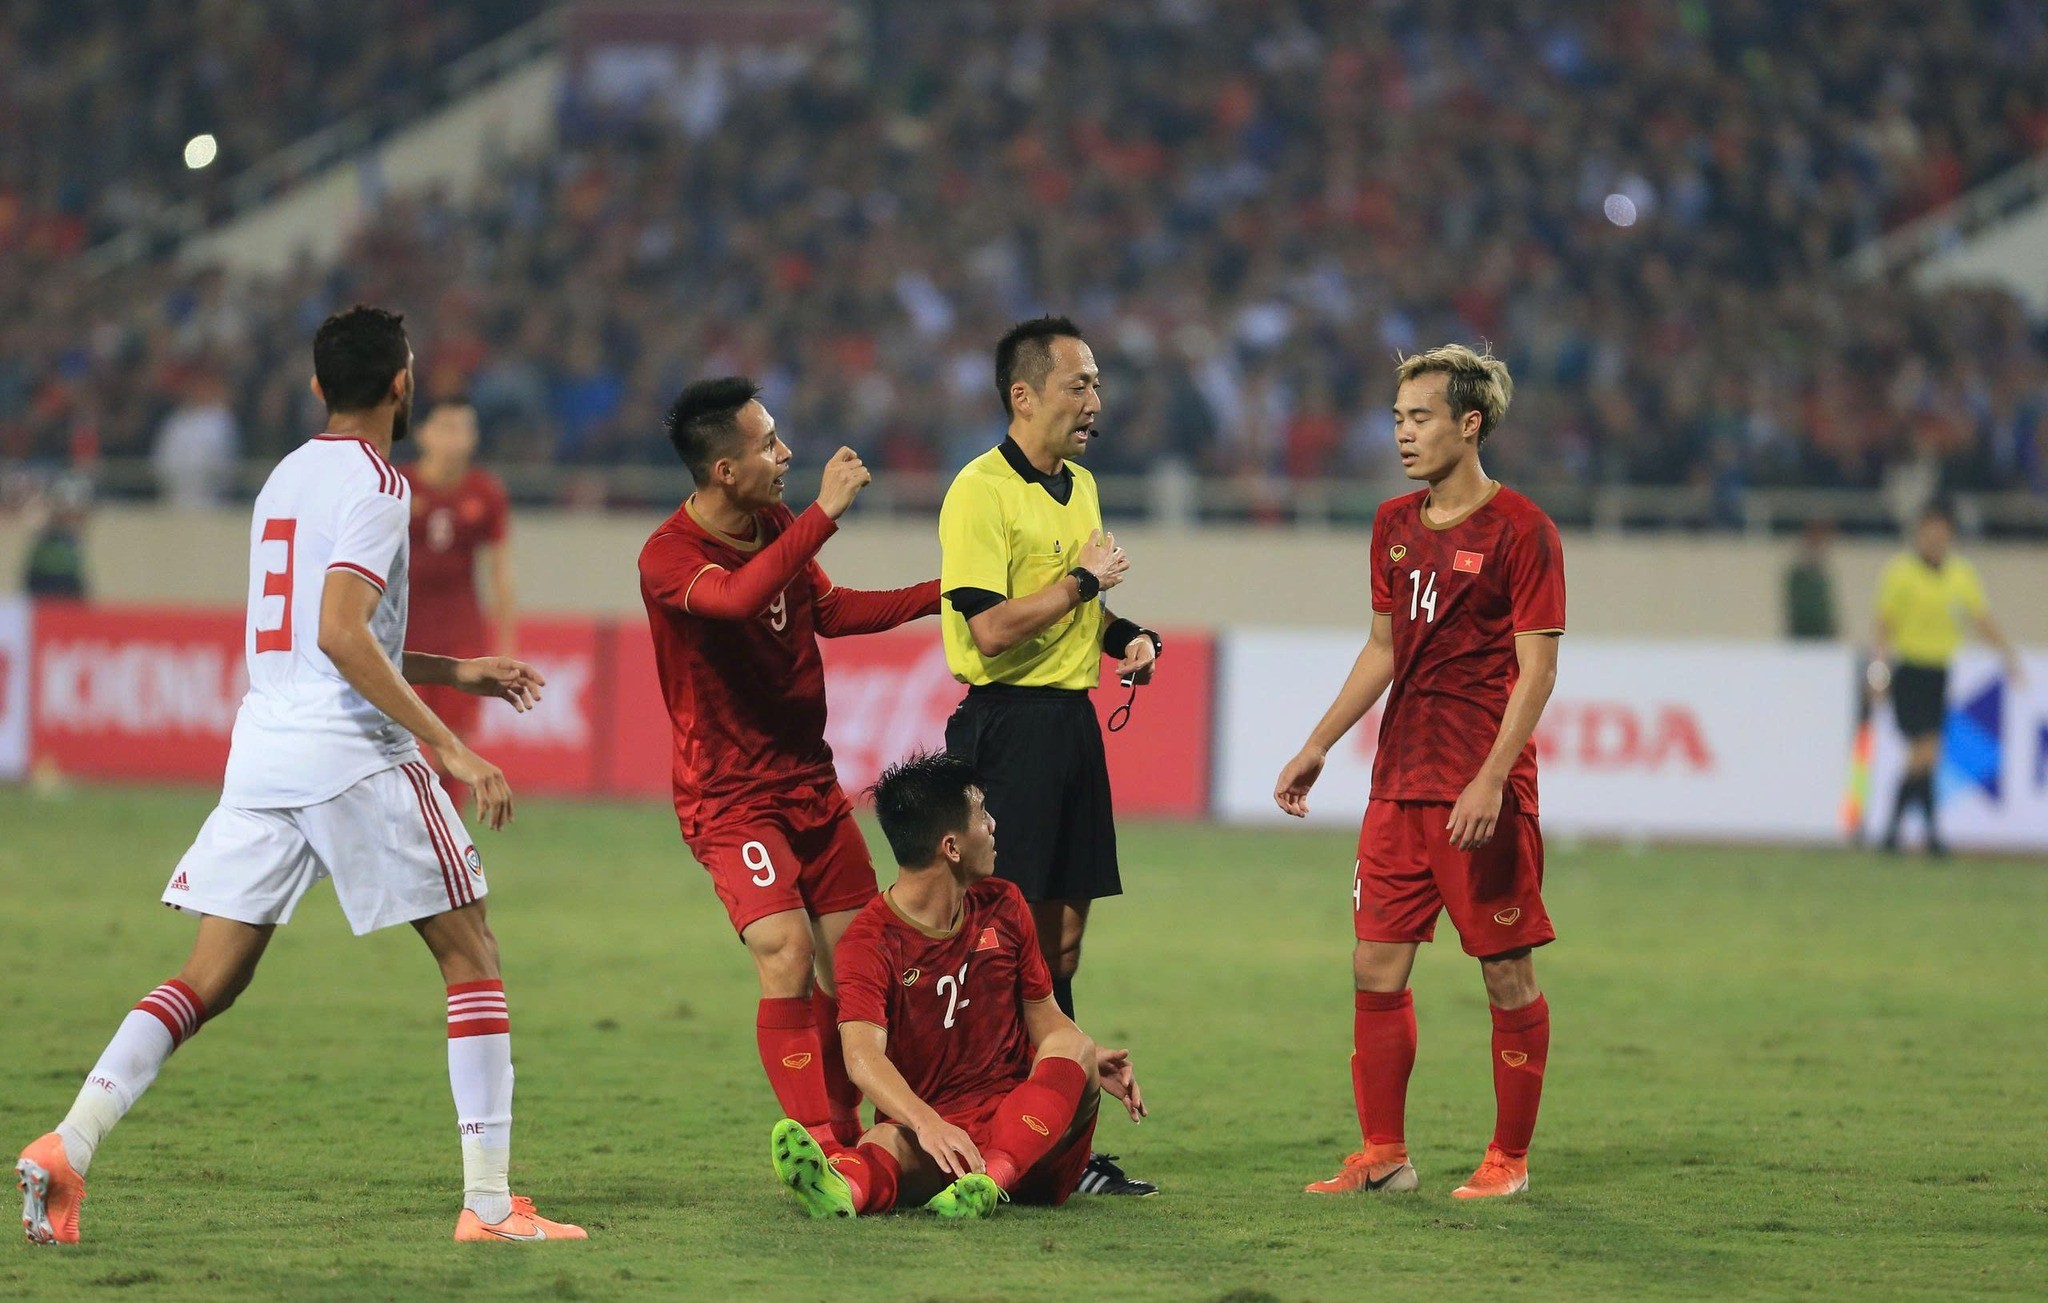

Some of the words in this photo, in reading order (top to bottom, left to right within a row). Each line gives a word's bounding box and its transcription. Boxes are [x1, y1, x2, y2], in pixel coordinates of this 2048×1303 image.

[256, 518, 297, 654] 3
[1409, 569, 1438, 623] 14
[742, 840, 776, 887] 9
